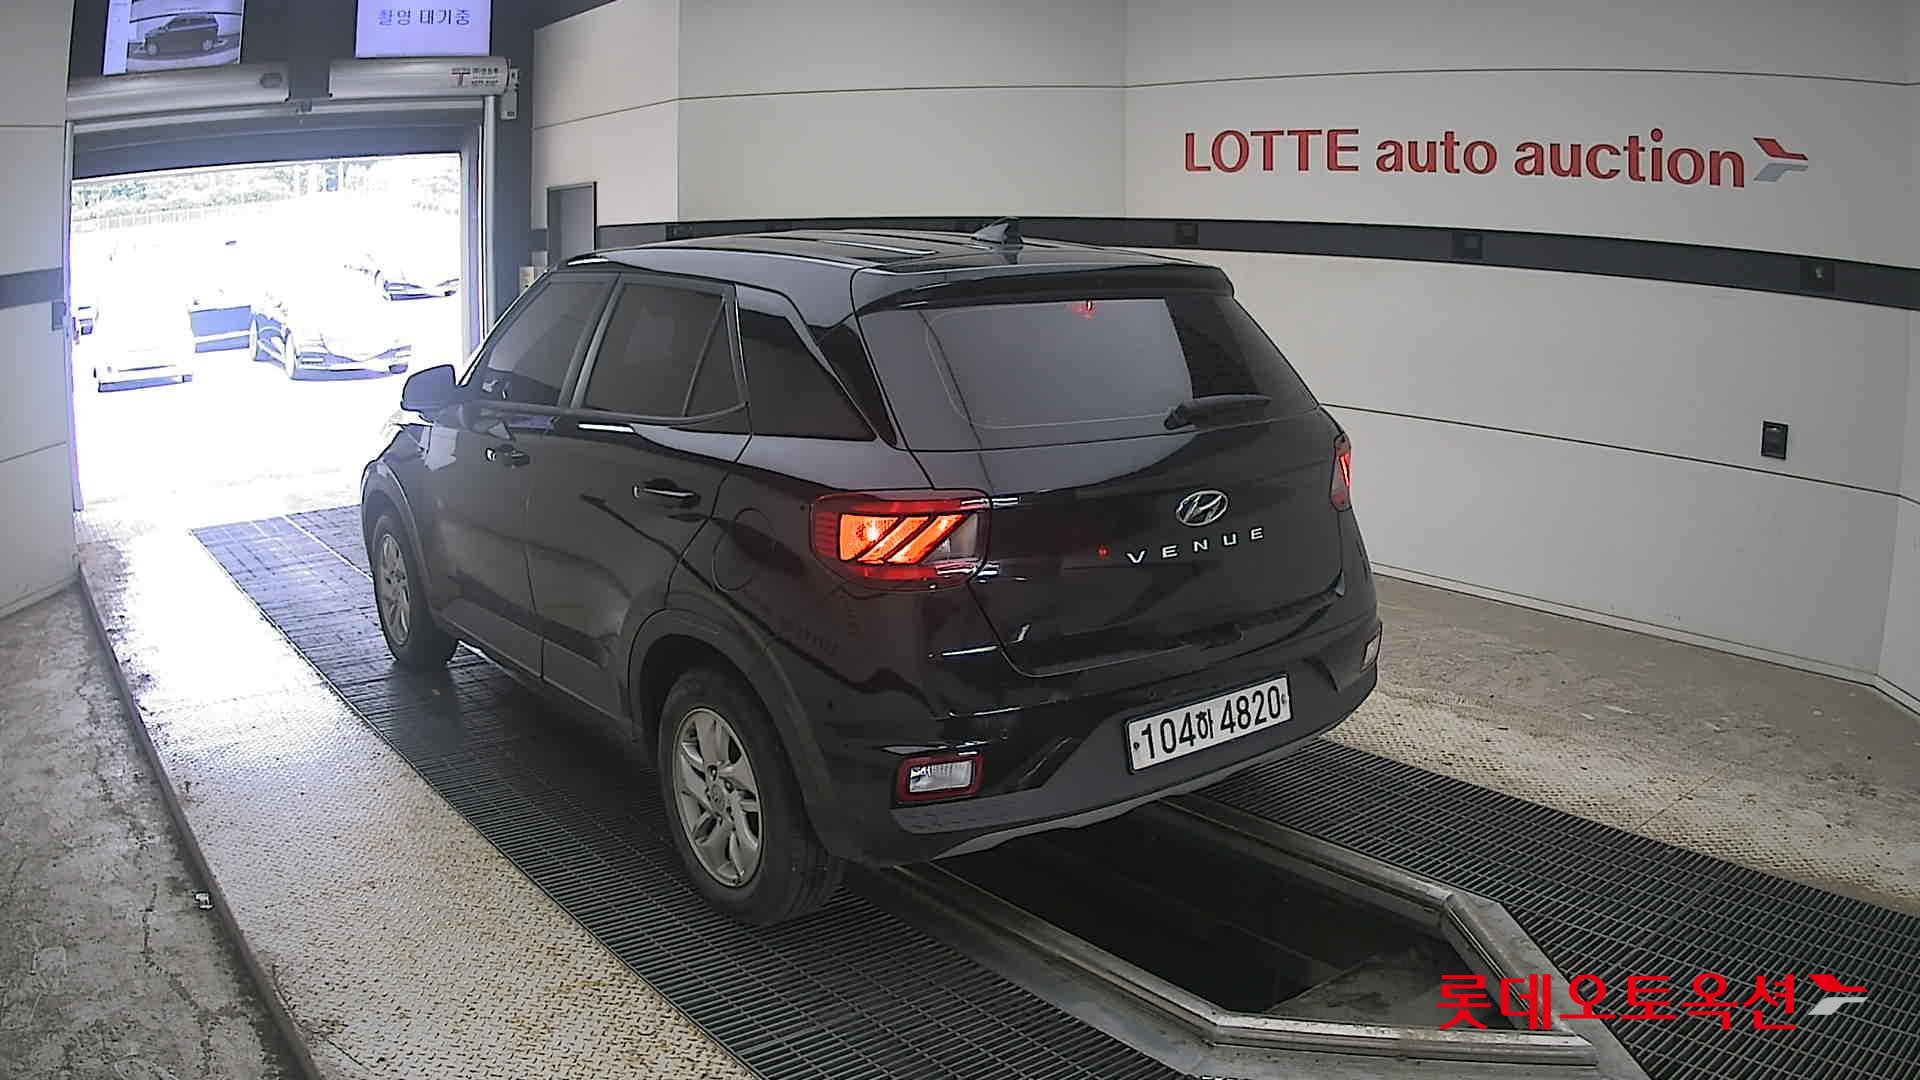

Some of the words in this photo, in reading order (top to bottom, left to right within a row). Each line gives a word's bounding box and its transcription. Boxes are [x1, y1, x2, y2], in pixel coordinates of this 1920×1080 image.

[420, 9, 471, 25] 대기중
[1184, 129, 1359, 172] LOTTE
[1376, 131, 1498, 174] auto
[1513, 129, 1745, 188] auction
[1127, 528, 1264, 564] VENUE
